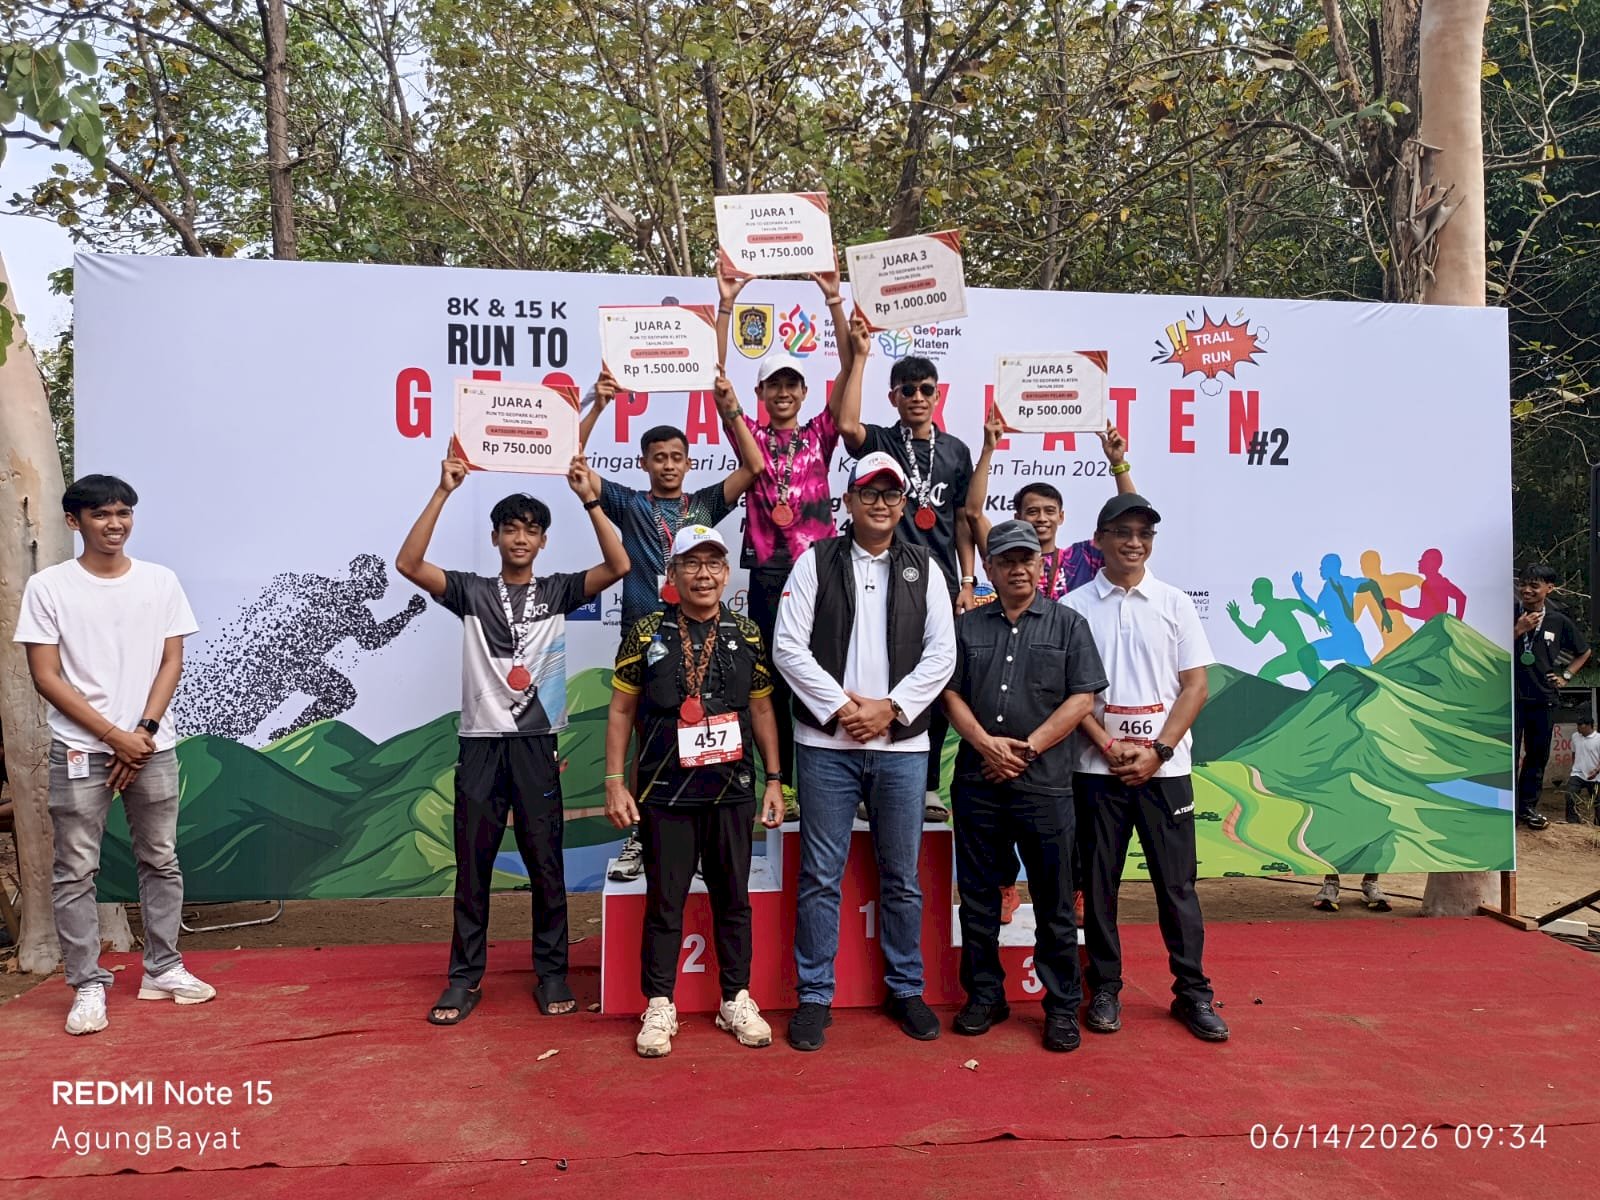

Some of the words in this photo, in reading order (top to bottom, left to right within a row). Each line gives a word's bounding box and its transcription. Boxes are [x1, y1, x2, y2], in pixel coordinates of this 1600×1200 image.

[750, 208, 786, 220] JUARA
[789, 207, 794, 216] 1
[741, 249, 756, 261] Rp
[760, 246, 814, 258] 1.750.000
[882, 254, 919, 269] JUARA
[920, 250, 928, 261] 3
[447, 298, 479, 316] 8K
[488, 299, 505, 317] &
[514, 301, 542, 318] 15
[551, 302, 567, 319] K
[875, 303, 891, 315] Rp
[893, 291, 947, 311] 1.000.000
[634, 321, 672, 333] JUARA
[675, 321, 681, 330] 2
[448, 323, 515, 366] RUN
[527, 326, 568, 368] TO
[913, 338, 949, 349] Klaten
[1193, 331, 1235, 346] TRAIL
[1201, 350, 1232, 365] RUN
[624, 364, 640, 377] Rp
[644, 362, 700, 374] 1.500.000
[1027, 365, 1064, 377] JUARA
[1067, 365, 1073, 374] 5
[491, 396, 532, 409] JUARA
[535, 399, 542, 409] 4
[1018, 405, 1034, 418] Rp
[1037, 405, 1082, 416] 500.000
[482, 441, 499, 455] Rp
[502, 442, 552, 455] 750.000
[1247, 427, 1290, 466] #2
[689, 454, 713, 471] ari
[1010, 459, 1066, 476] Tahun
[1119, 720, 1153, 735] 466
[694, 730, 727, 749] 457
[859, 901, 875, 938] 1
[682, 934, 706, 973] 2
[1022, 956, 1043, 994] 3
